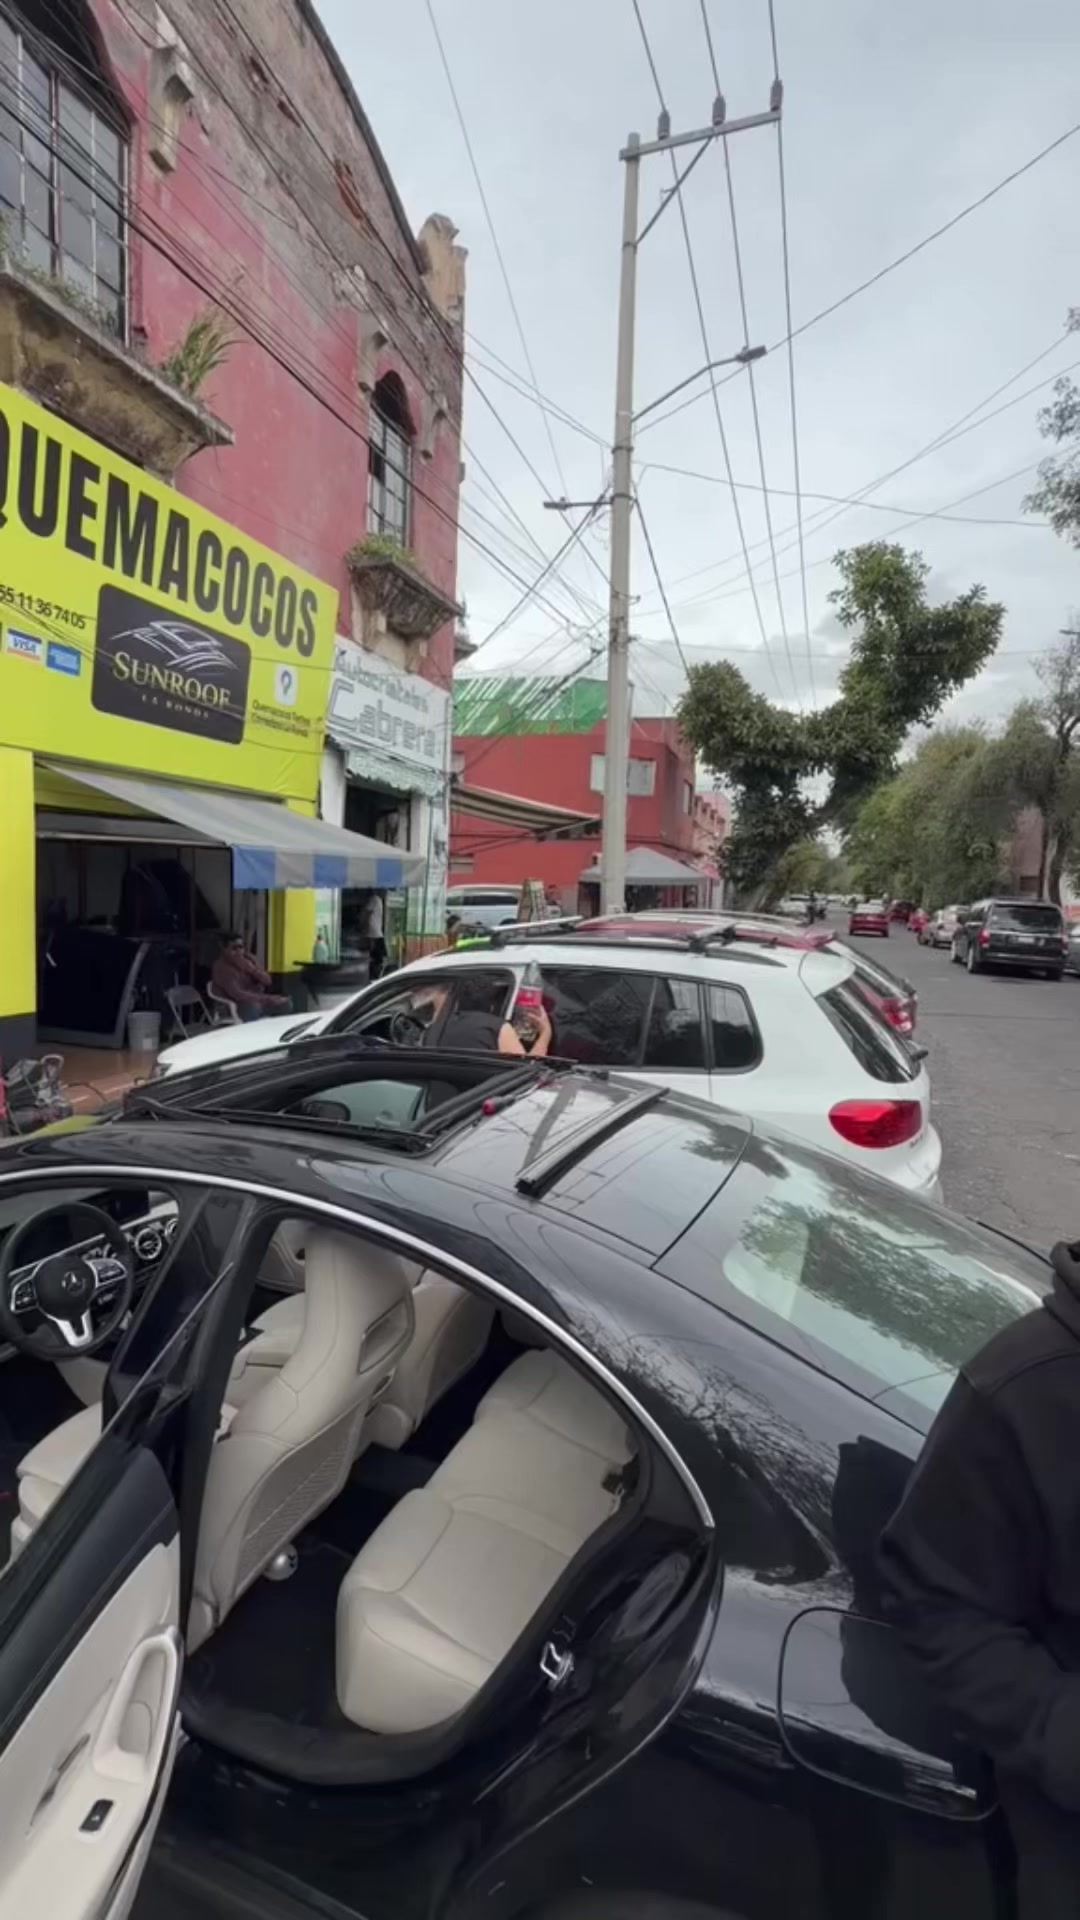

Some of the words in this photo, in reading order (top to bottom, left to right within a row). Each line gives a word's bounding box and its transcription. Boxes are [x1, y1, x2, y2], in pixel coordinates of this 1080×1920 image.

[0, 409, 319, 657] UEMACOCOS
[13, 637, 37, 654] VISA
[112, 651, 231, 708] SUNROOF
[325, 678, 437, 759] Cabrera
